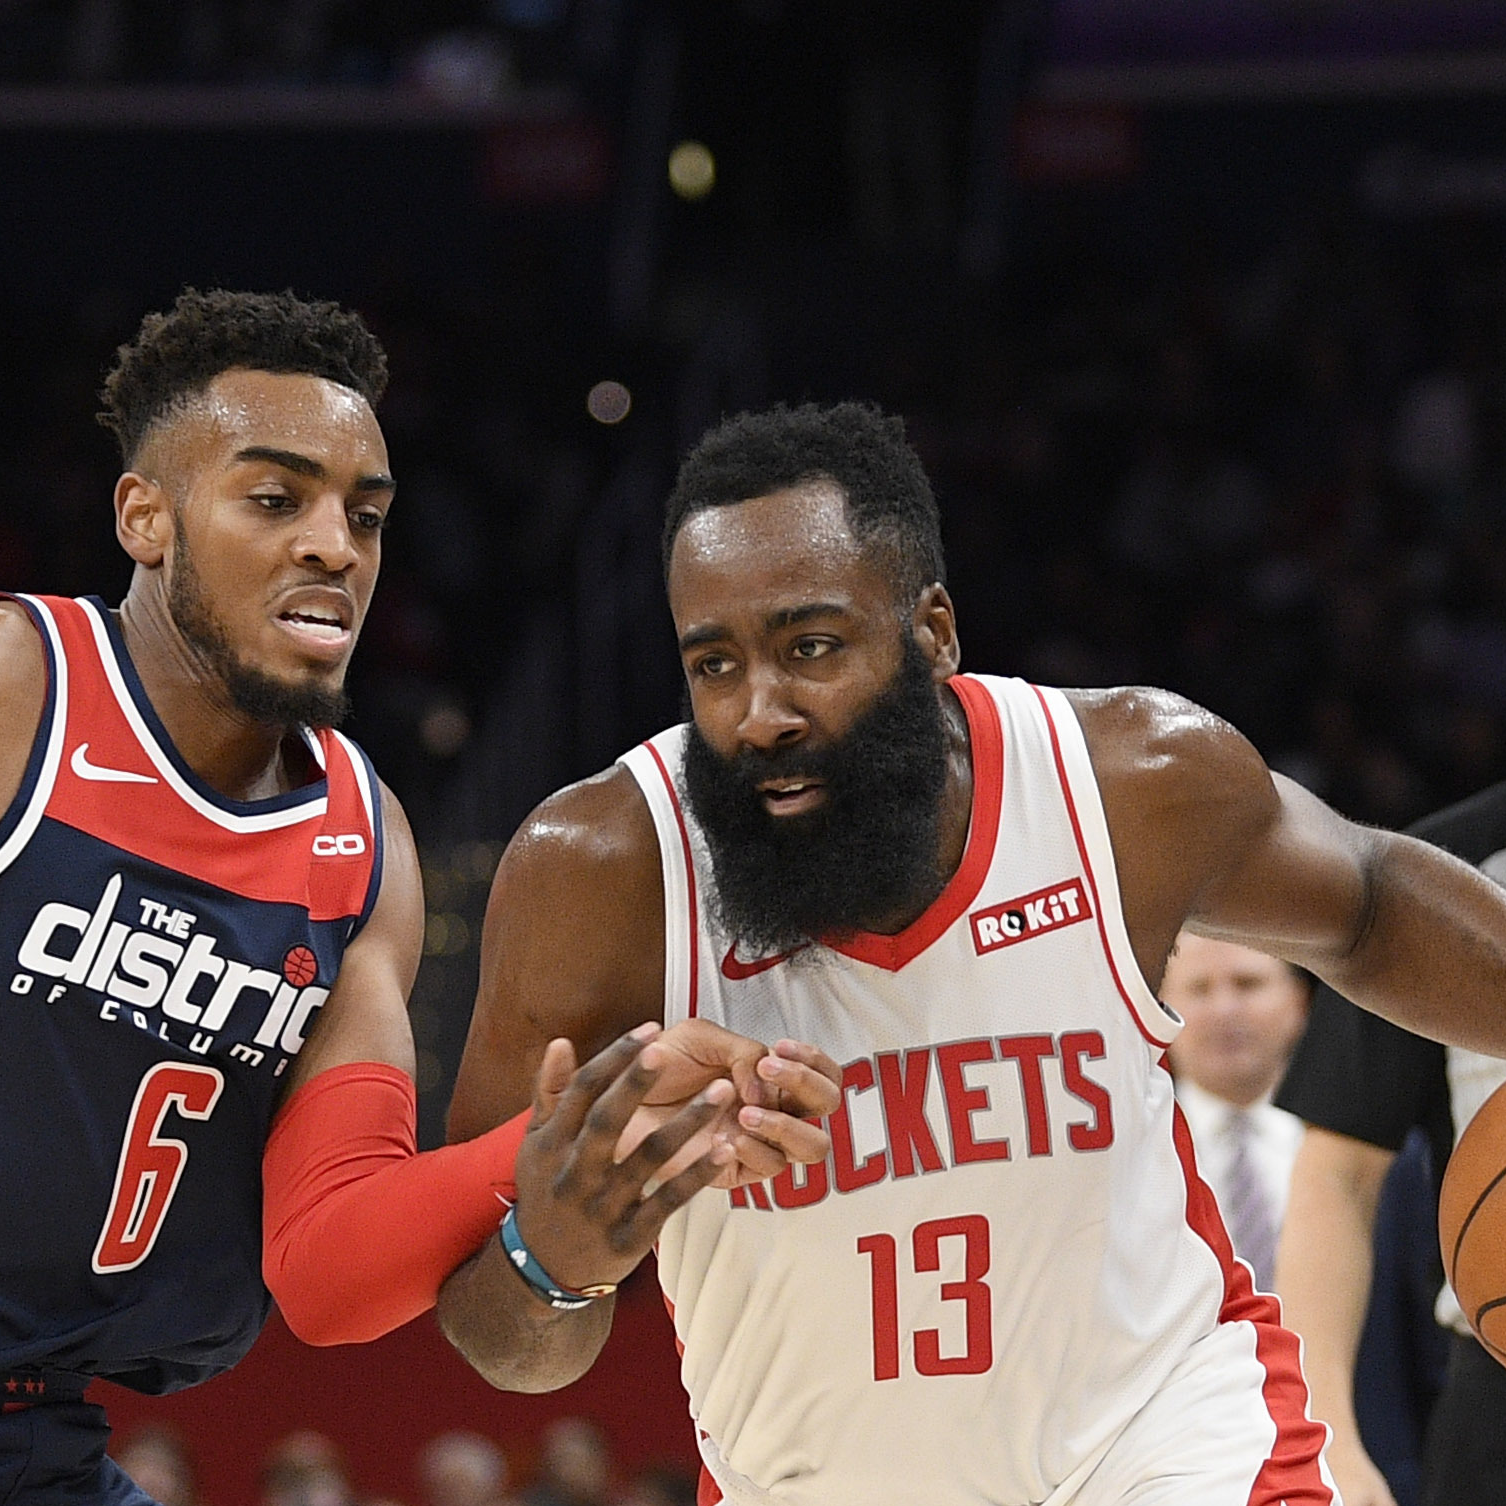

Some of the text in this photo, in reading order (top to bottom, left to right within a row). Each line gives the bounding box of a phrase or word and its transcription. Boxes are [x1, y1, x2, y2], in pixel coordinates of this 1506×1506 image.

[10, 974, 67, 1004] OF
[140, 898, 197, 940] THE
[92, 1061, 225, 1275] 6
[729, 1029, 1115, 1212] OCKETS
[857, 1214, 994, 1382] 13
